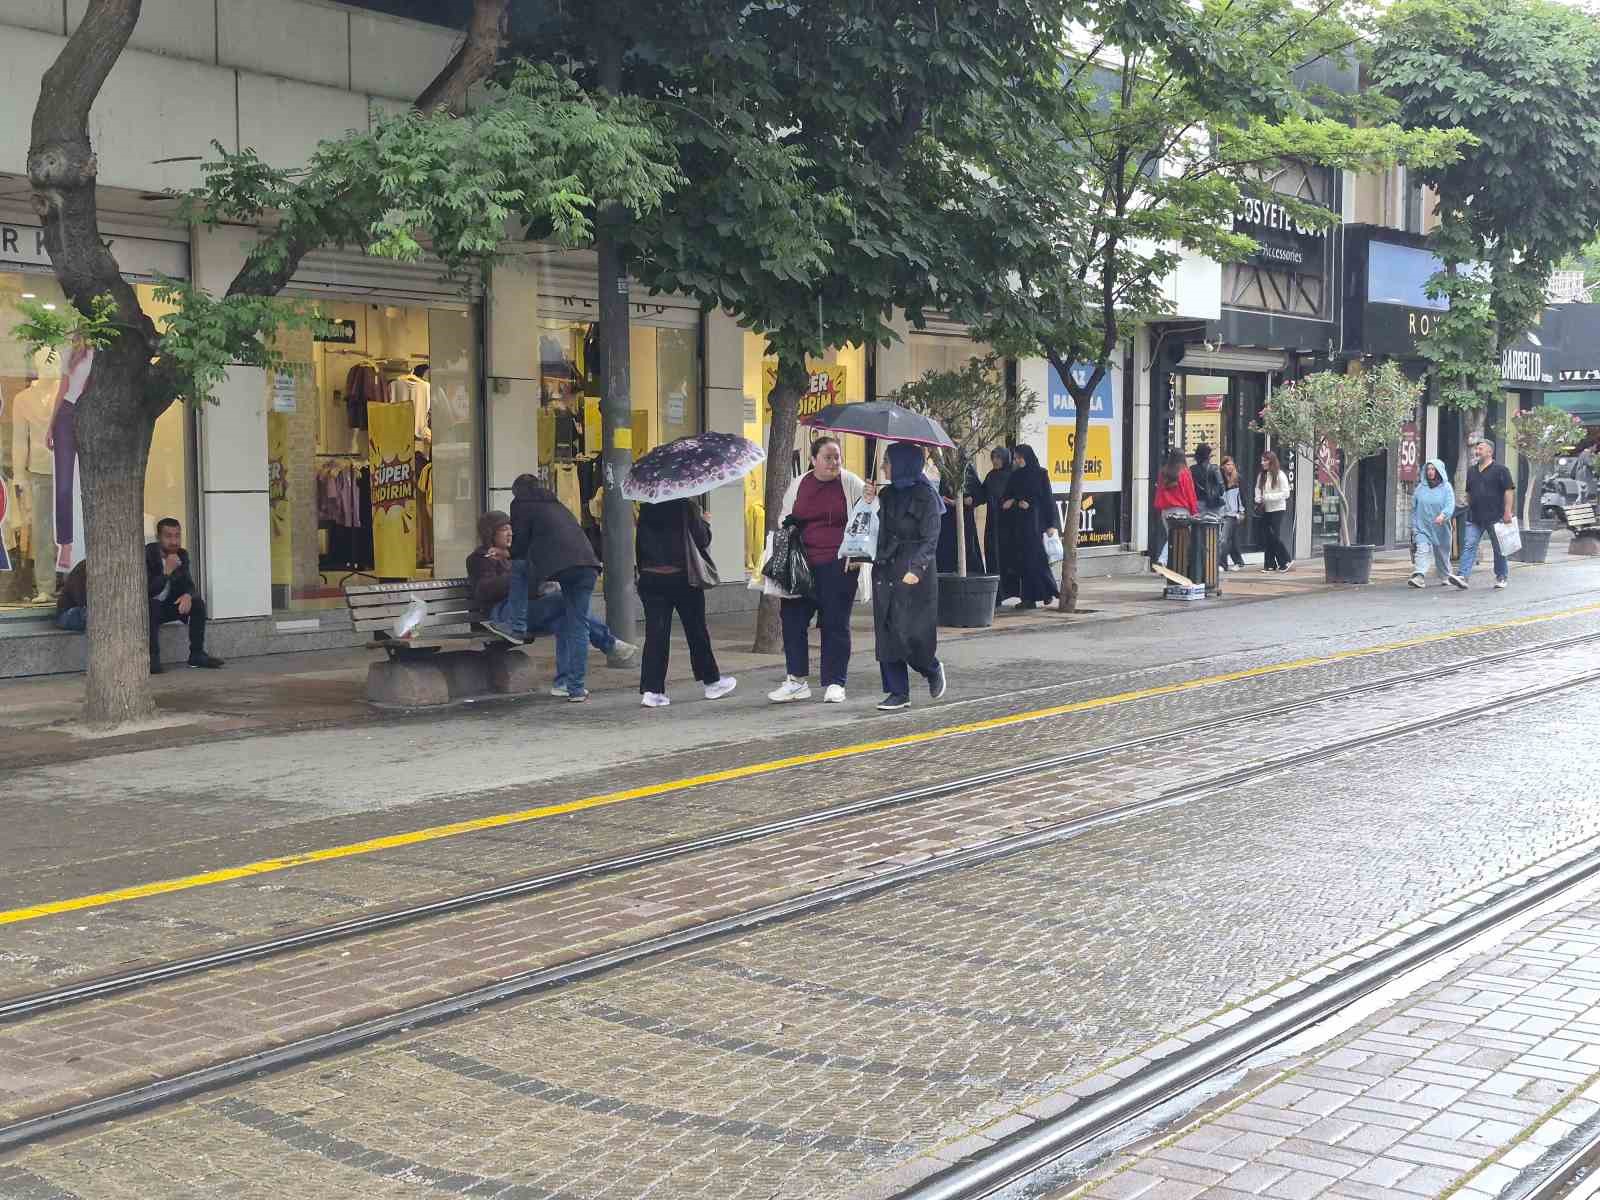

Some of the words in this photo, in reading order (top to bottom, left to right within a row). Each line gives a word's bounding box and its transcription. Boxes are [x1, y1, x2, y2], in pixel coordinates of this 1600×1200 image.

[1501, 349, 1541, 381] BARGELLO
[1401, 440, 1416, 465] 50
[374, 463, 411, 487] SÜPER
